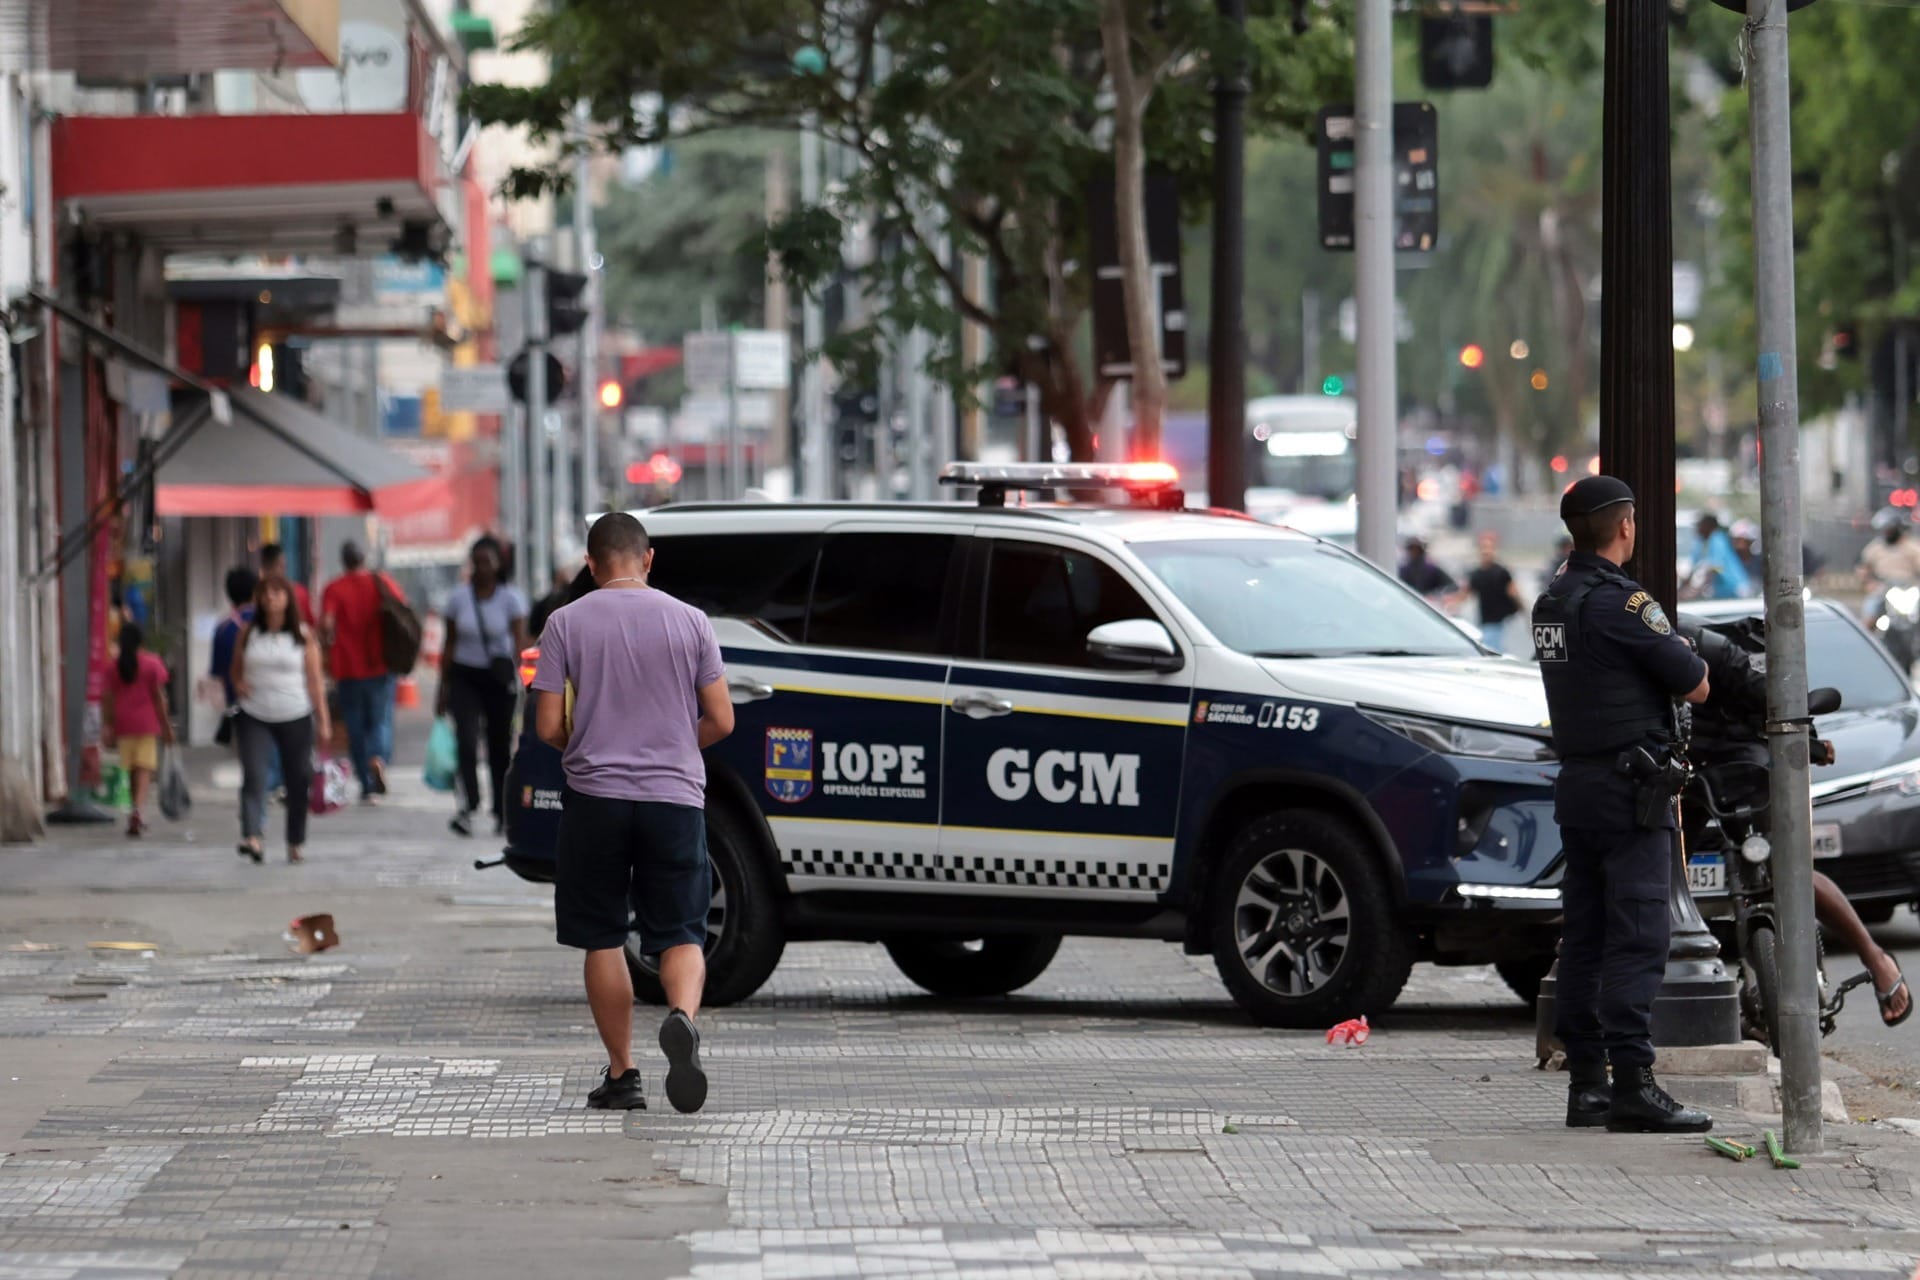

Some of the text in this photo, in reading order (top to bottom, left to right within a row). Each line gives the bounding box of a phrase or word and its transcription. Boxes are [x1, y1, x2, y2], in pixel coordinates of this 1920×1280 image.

[1534, 626, 1563, 649] GCM
[1207, 711, 1255, 725] SÃO PAULO
[1209, 703, 1247, 714] CIDADE DE
[1272, 705, 1320, 731] 153
[821, 742, 925, 784] IOPE
[986, 747, 1140, 807] GCM
[823, 784, 926, 799] OPERAÇÕES ESPECIAIS
[1687, 866, 1717, 888] A51
